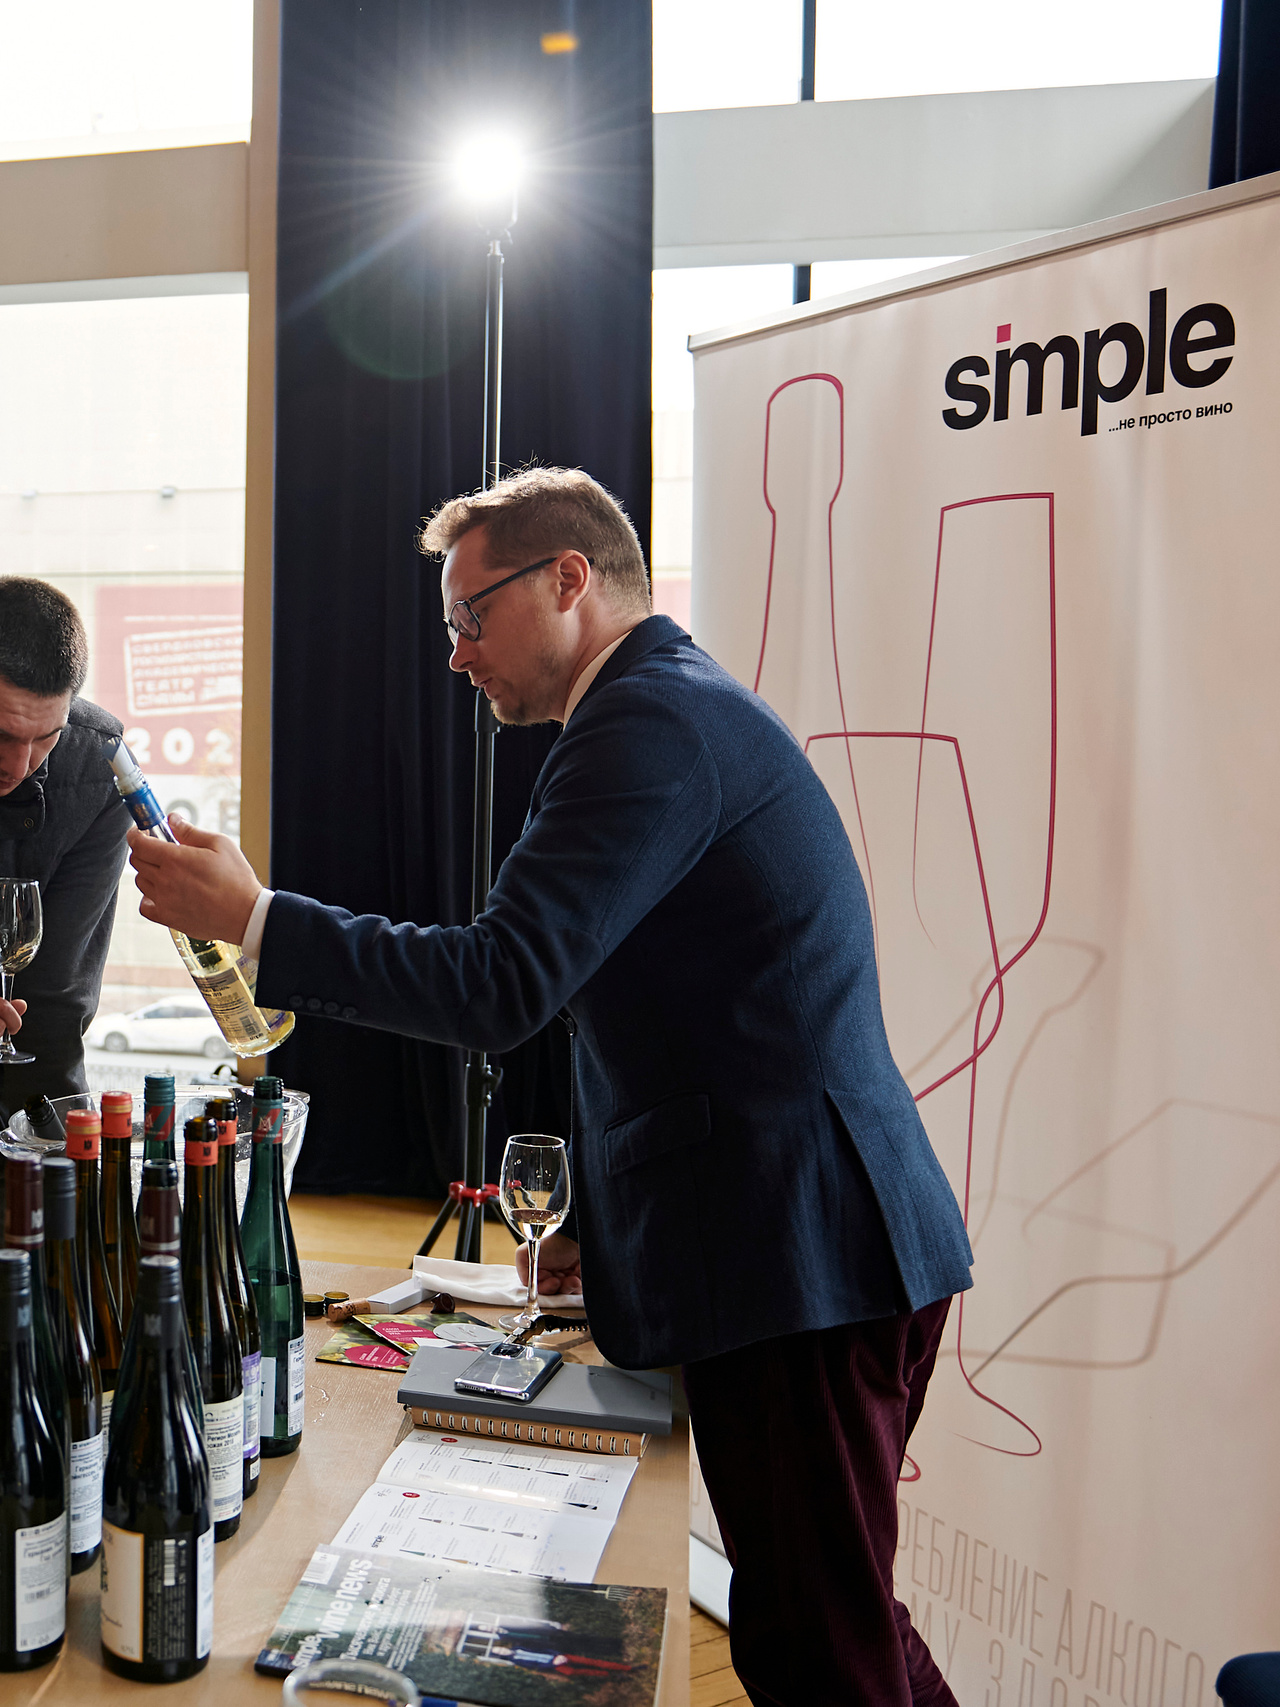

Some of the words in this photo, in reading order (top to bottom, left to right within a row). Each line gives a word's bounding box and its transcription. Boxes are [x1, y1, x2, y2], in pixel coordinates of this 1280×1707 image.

[942, 287, 1236, 437] simple
[1138, 408, 1192, 430] просто
[1195, 402, 1233, 418] вино
[135, 677, 195, 693] ТЕАТР
[334, 1558, 373, 1601] news
[315, 1600, 354, 1640] wine
[290, 1634, 323, 1669] simple
